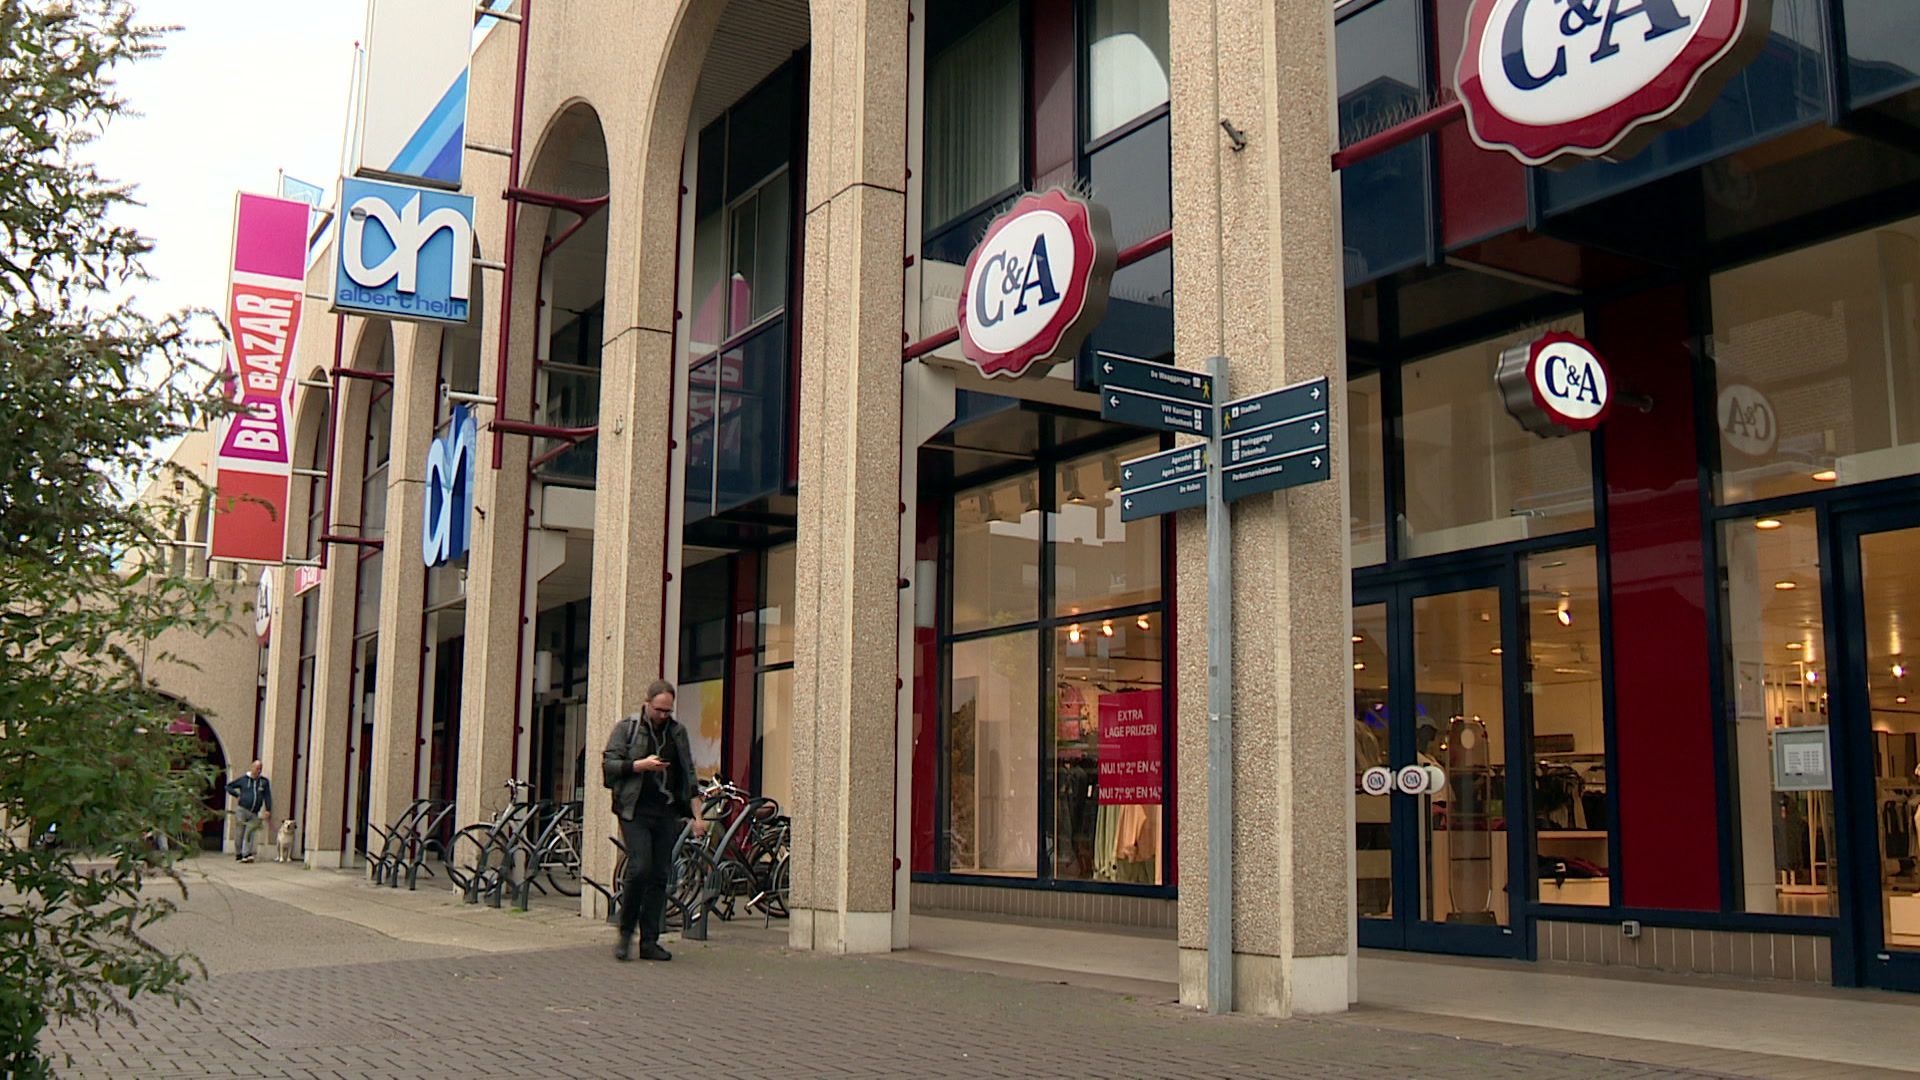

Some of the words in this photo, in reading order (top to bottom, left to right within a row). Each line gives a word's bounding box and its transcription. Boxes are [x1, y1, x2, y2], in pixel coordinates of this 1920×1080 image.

[975, 232, 1060, 328] C&A
[339, 287, 412, 310] albert
[416, 297, 467, 317] heijn
[235, 293, 294, 392] BAZAR
[1544, 354, 1602, 406] C&A
[232, 402, 280, 452] BIG
[1104, 726, 1125, 738] LAGE
[1125, 723, 1157, 737] PRIJZEN
[1117, 709, 1144, 722] EXTRA
[1100, 762, 1116, 775] NU!
[1136, 760, 1149, 773] EN
[1098, 787, 1114, 800] NU!
[1136, 786, 1148, 799] EN
